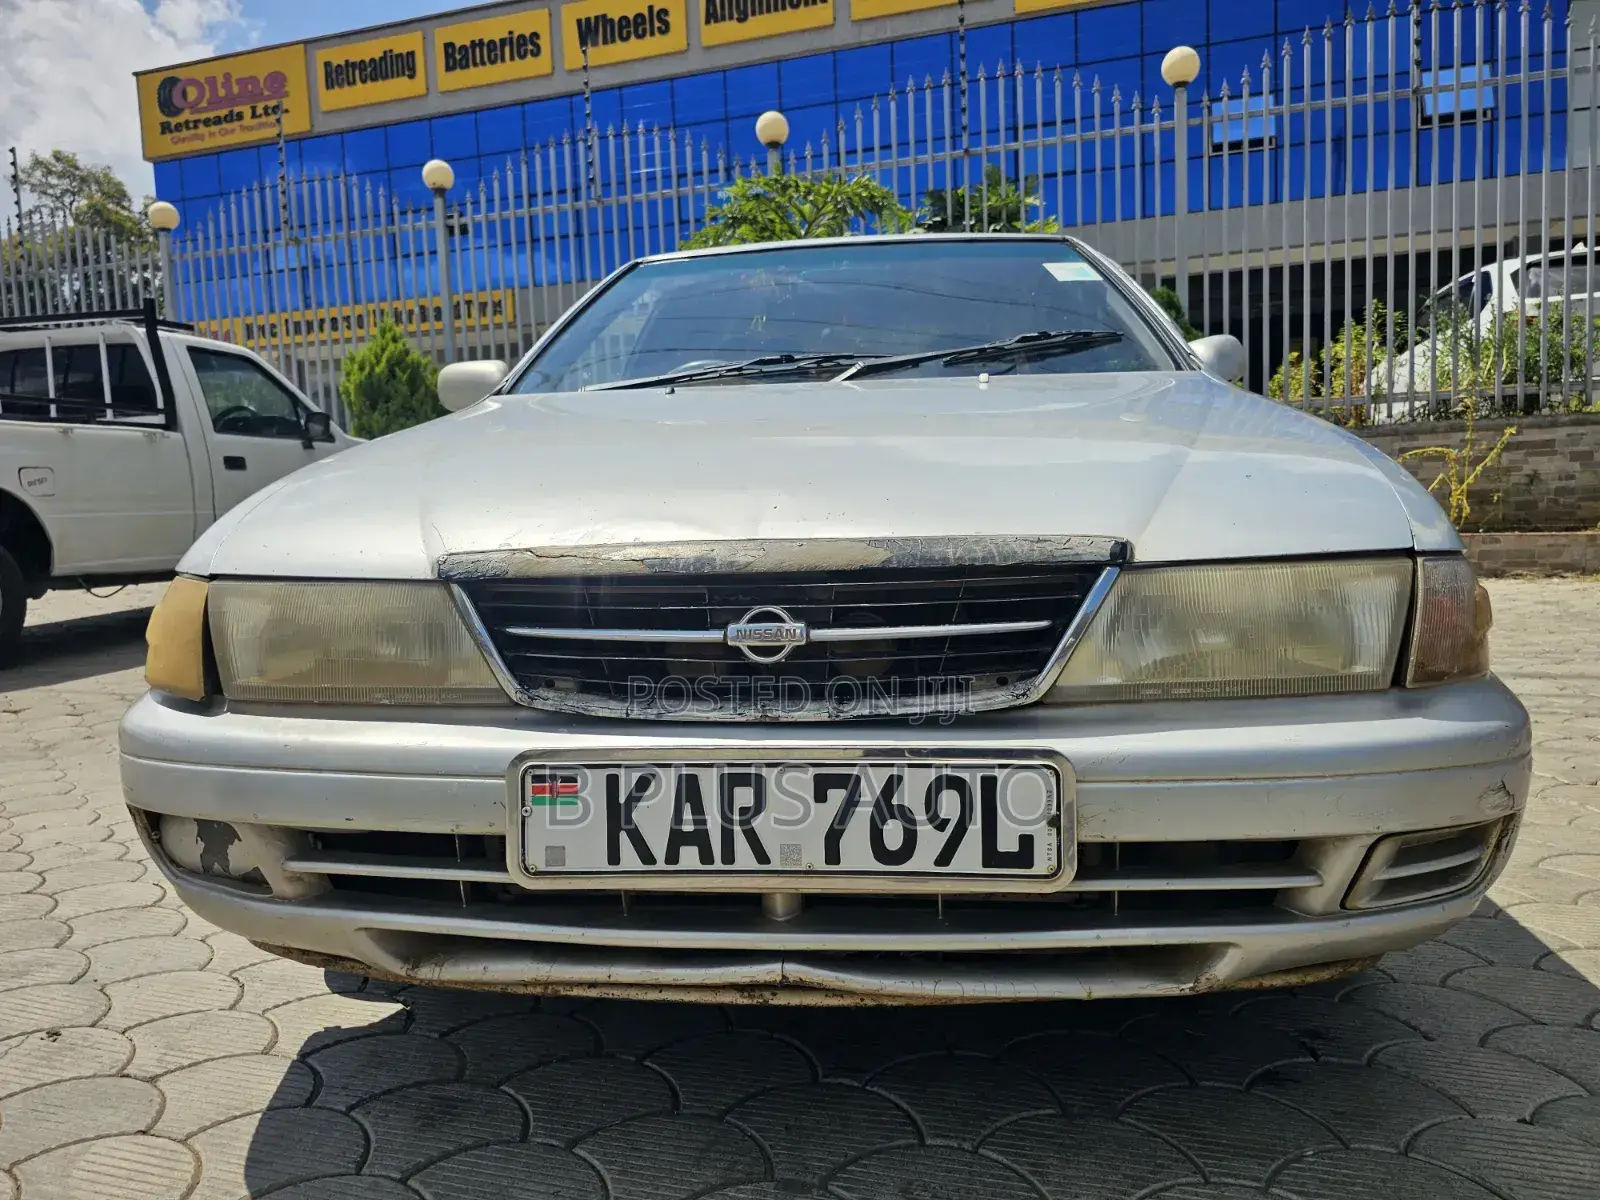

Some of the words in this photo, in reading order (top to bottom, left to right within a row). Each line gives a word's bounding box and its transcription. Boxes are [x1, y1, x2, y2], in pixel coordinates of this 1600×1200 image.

[576, 5, 671, 50] Wheels
[323, 49, 417, 91] Retreading
[443, 30, 542, 73] Batteries
[159, 109, 245, 136] Retreads
[736, 628, 797, 641] NISSAN
[605, 773, 772, 866] KAR
[813, 773, 1035, 869] 769L
